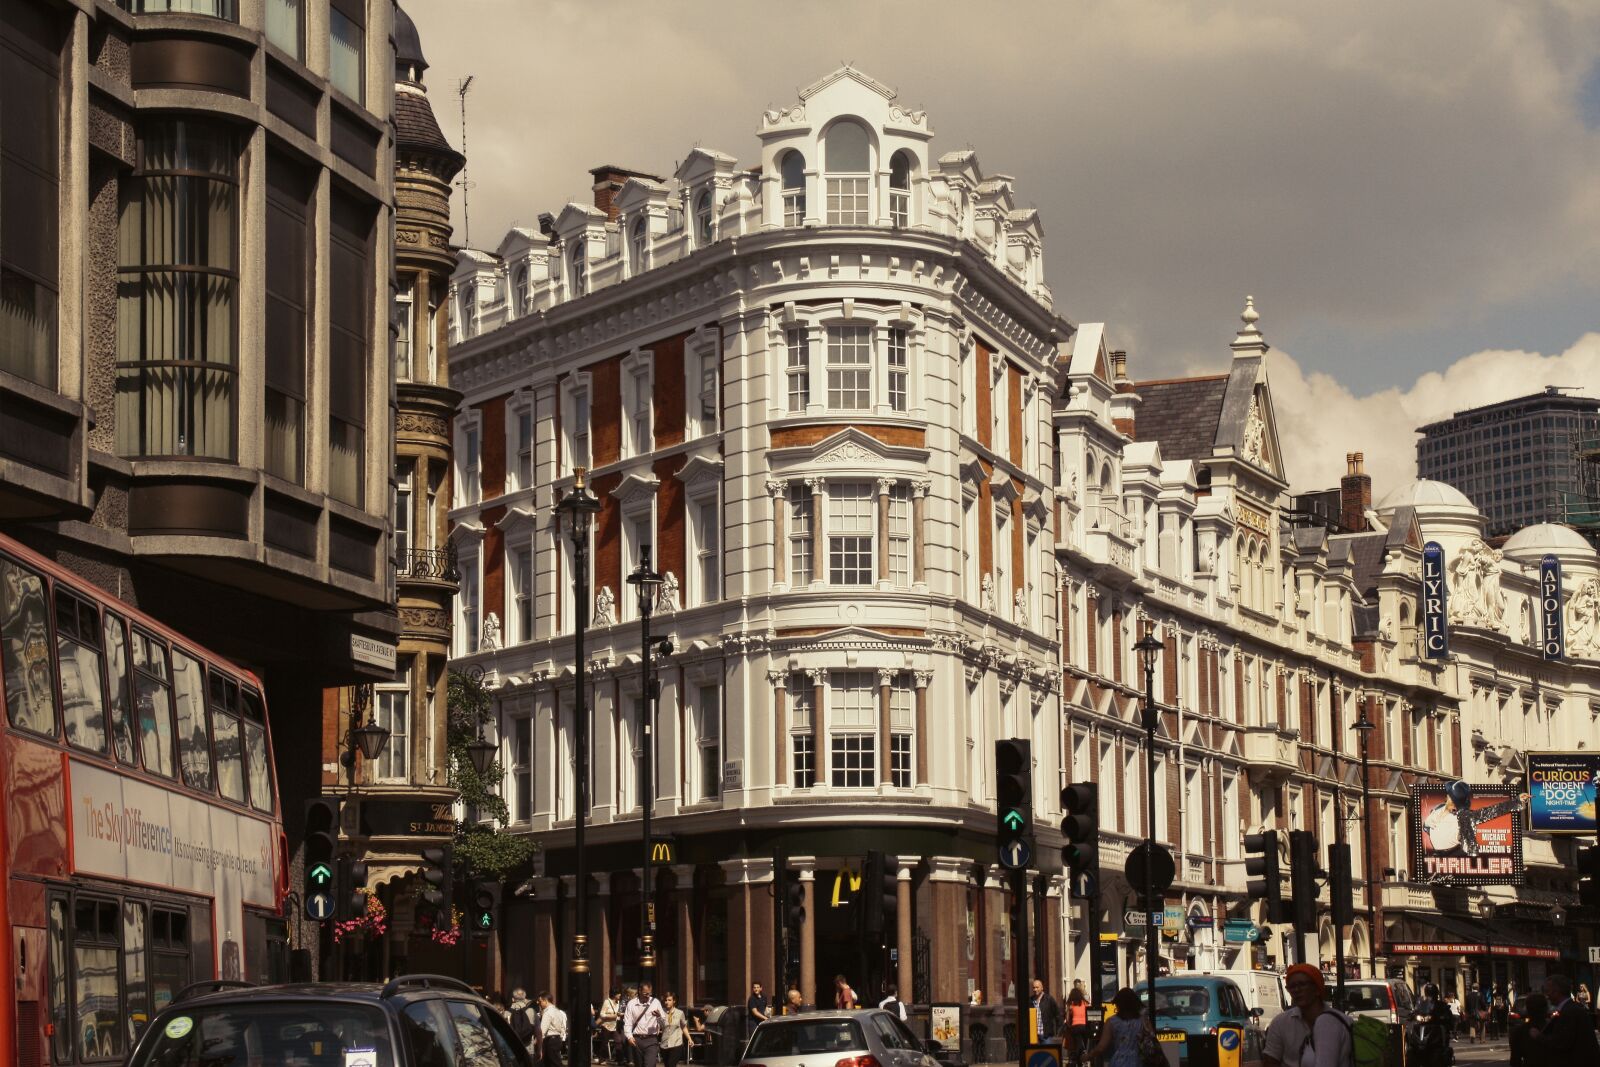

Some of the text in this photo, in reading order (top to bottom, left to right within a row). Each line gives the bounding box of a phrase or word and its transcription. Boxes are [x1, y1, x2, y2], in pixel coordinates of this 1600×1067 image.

[1426, 562, 1444, 650] LYRIC
[1544, 570, 1560, 655] APOLLO
[352, 638, 375, 652] SHAFTESBURY
[376, 643, 389, 656] AVENUE
[1532, 771, 1590, 782] CURIOUS
[1546, 790, 1576, 800] DOG
[82, 795, 172, 854] The Sky Difference
[174, 836, 182, 858] It's
[1424, 857, 1512, 874] THRILLER
[1426, 872, 1454, 884] Live
